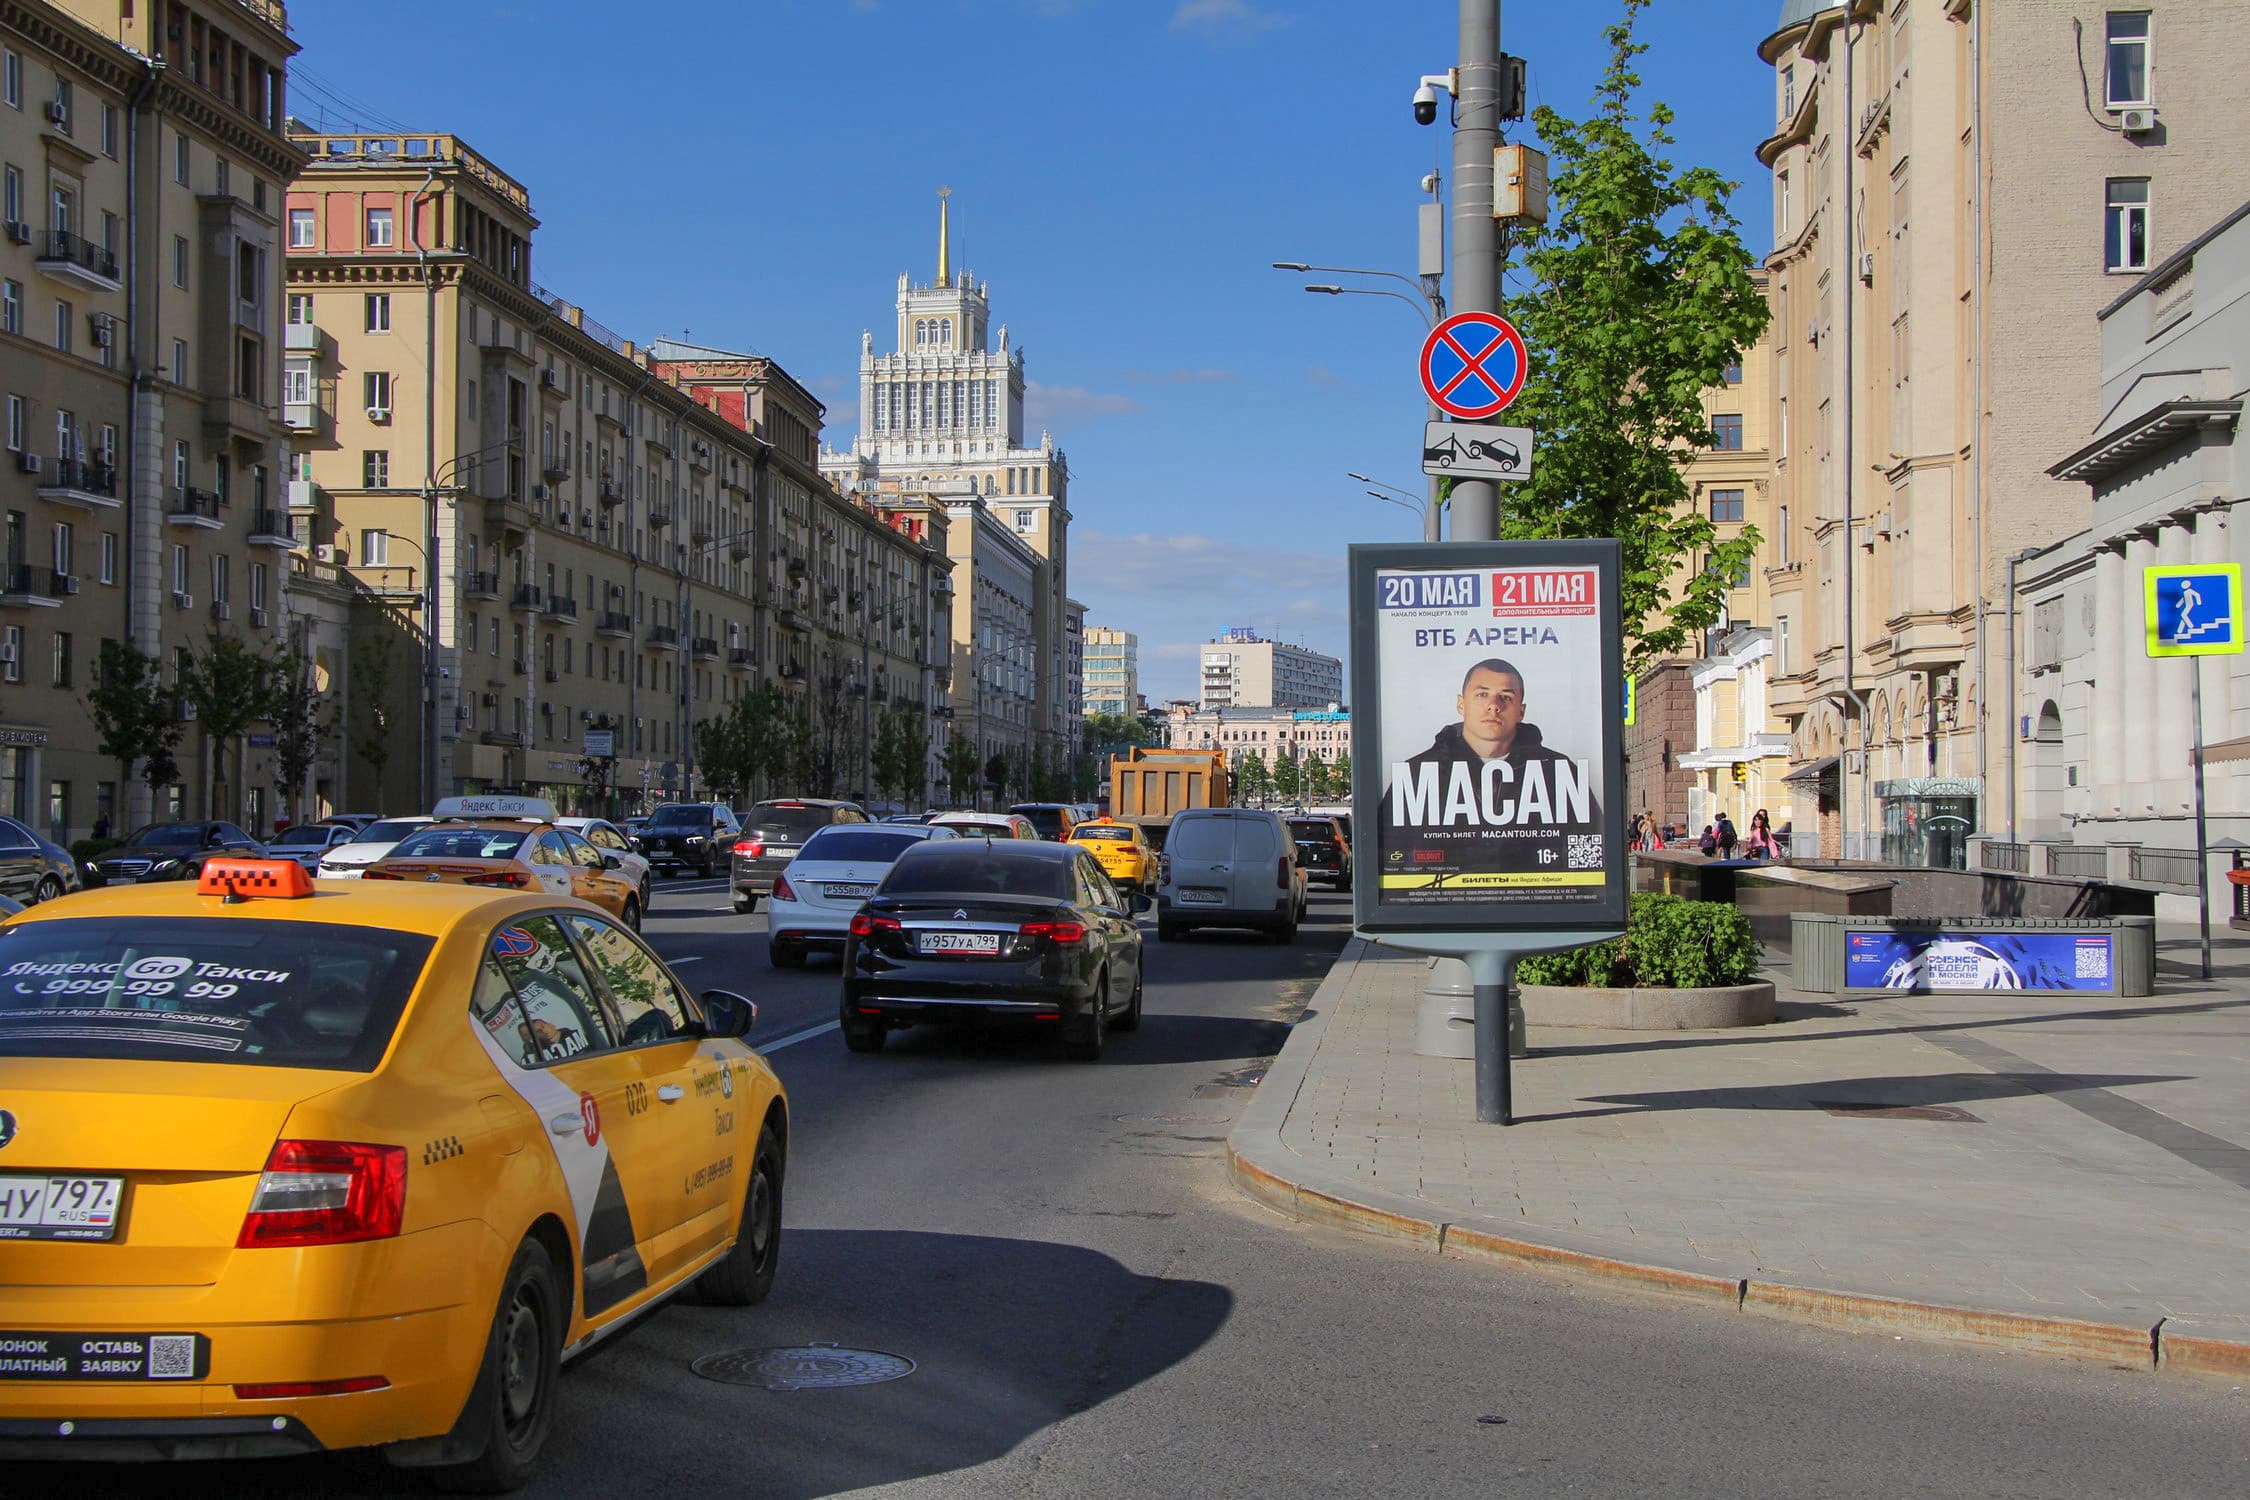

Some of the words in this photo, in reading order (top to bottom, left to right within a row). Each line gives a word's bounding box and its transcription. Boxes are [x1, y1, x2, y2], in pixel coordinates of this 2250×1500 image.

[1385, 577, 1415, 606] 20
[1422, 576, 1473, 606] МАЯ
[1502, 575, 1528, 604] 21
[1535, 574, 1585, 603] МАЯ
[1496, 607, 1560, 617] ДОПОЛНИТЕЛЬНЫЙ
[1561, 607, 1591, 616] КОНЦЕРТ
[1415, 628, 1456, 647] ВТБ
[1465, 627, 1559, 646] АРЕНА
[1391, 759, 1591, 827] MACAN
[461, 799, 495, 813] Яндекс
[497, 799, 525, 812] Такси
[1423, 832, 1451, 840] КУПИТЬ
[1481, 830, 1560, 839] MACANTOUR.COM
[1537, 848, 1559, 864] 16+
[925, 935, 973, 949] У957УА
[976, 936, 995, 946] 799
[1, 961, 124, 977] Яндекс
[134, 960, 181, 976] Go
[194, 962, 291, 985] Такси
[1928, 964, 1978, 972] НЕДЕЛЯ
[67, 1009, 96, 1018] App
[98, 1009, 131, 1017] Store
[161, 1013, 209, 1025] Google
[209, 1015, 241, 1026] Play
[625, 1081, 648, 1117] 020
[51, 1180, 108, 1209] 797
[58, 1210, 88, 1222] RUS
[81, 1341, 143, 1354] ОСТАВЬ
[0, 1357, 67, 1372] ЛАТНЫЙ
[81, 1360, 143, 1373] ЗАЯВКУ
